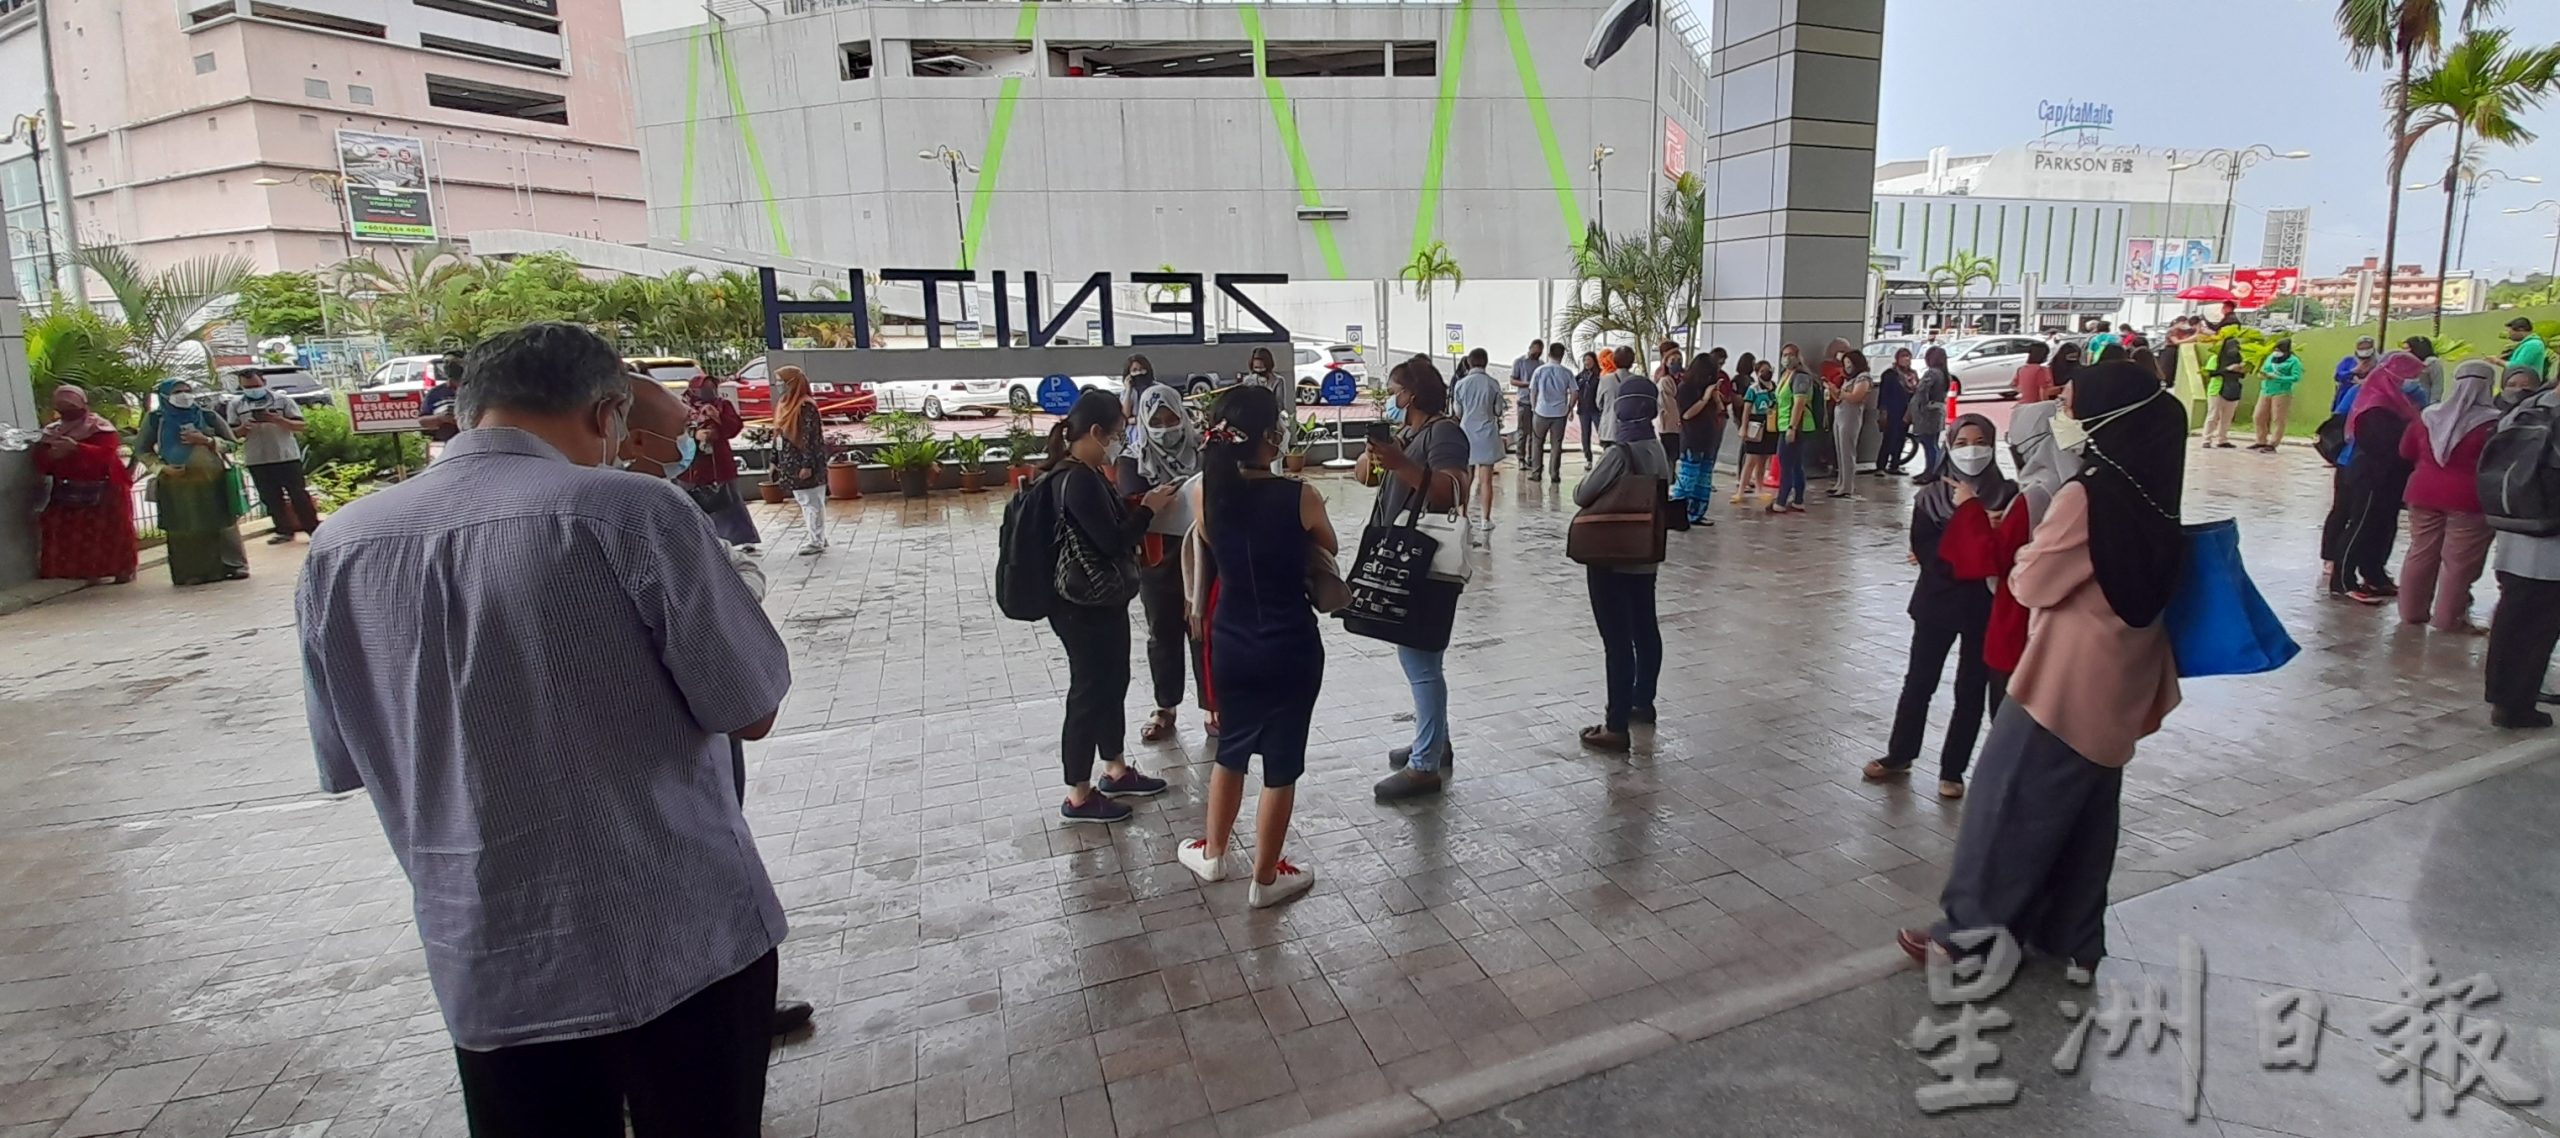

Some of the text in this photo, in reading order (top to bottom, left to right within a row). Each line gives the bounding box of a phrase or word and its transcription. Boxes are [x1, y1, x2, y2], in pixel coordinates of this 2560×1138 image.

[2038, 97, 2114, 127] CapitaMalls
[2079, 133, 2099, 146] Asia
[2034, 153, 2134, 173] PARKSON 百盛
[1051, 377, 1061, 391] P
[1335, 372, 1344, 385] P
[353, 401, 419, 412] RESERVED
[354, 409, 420, 421] PARKING
